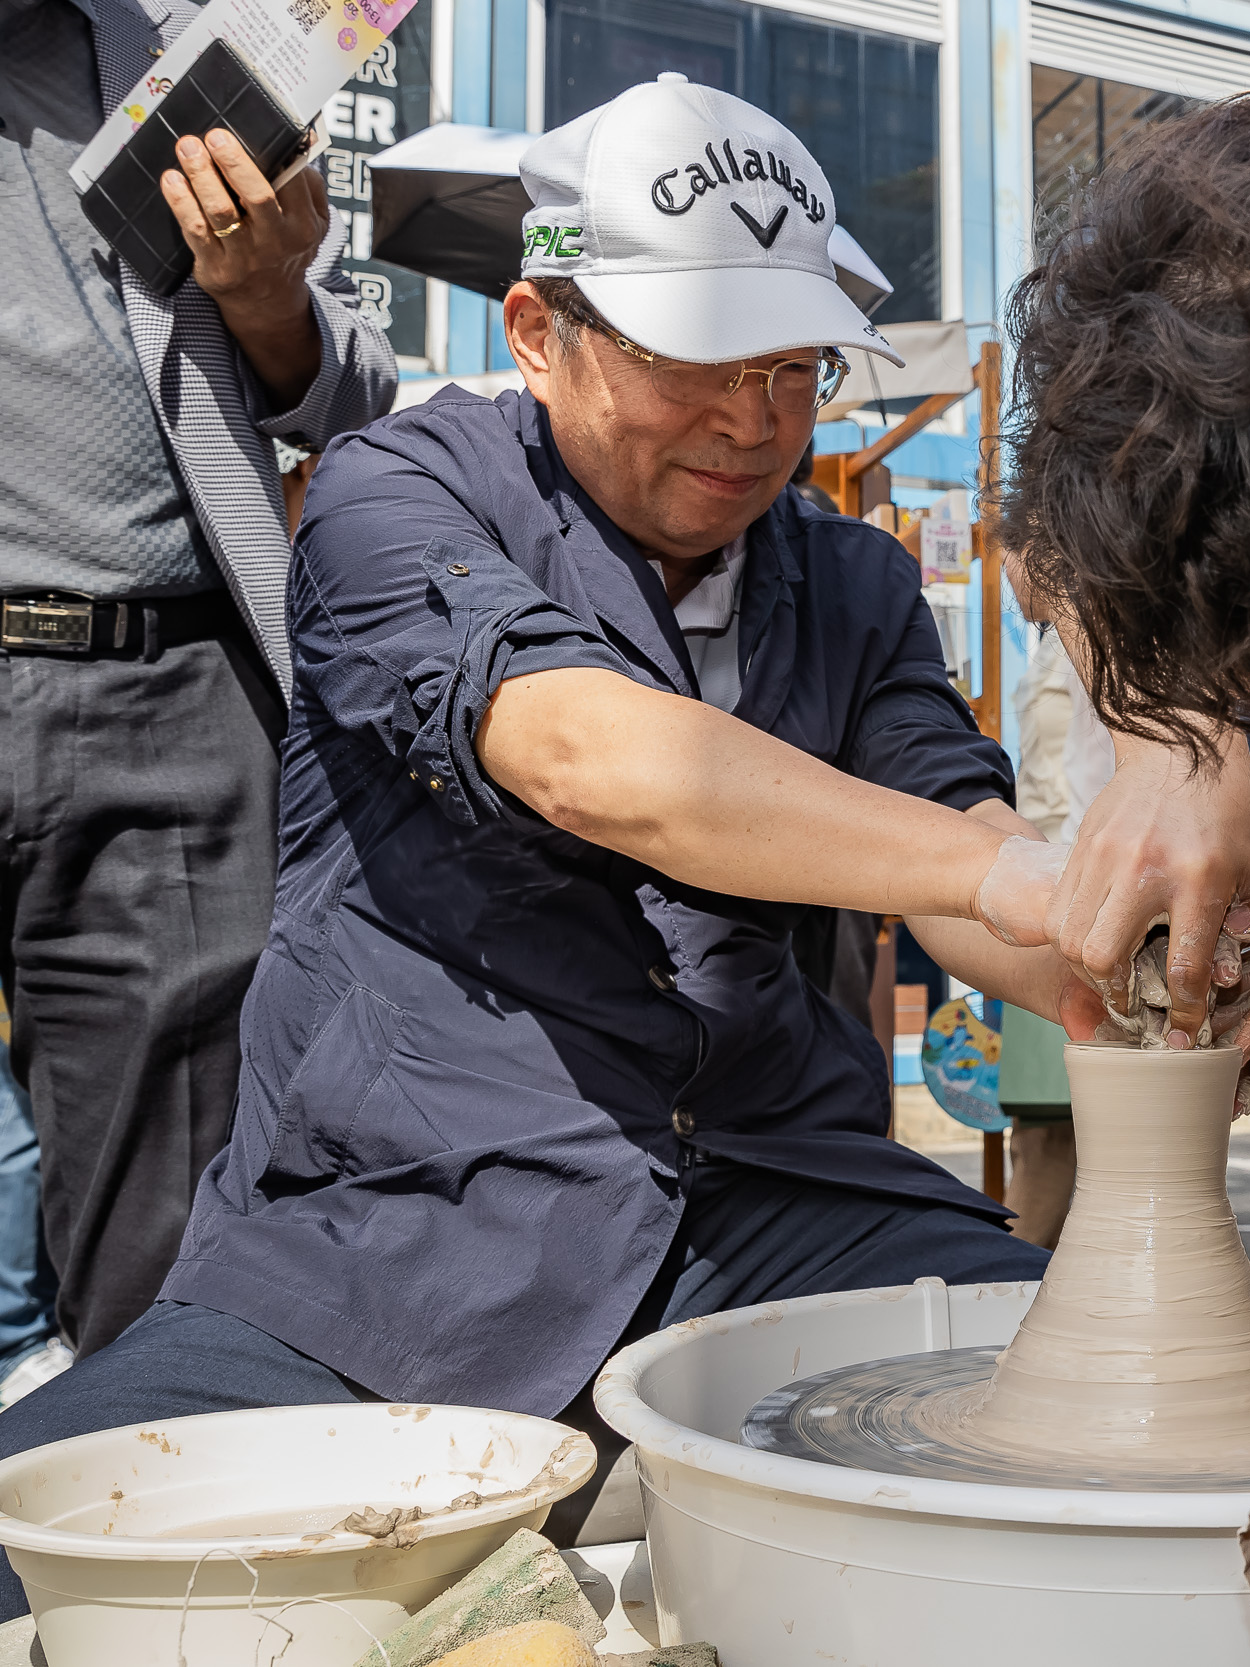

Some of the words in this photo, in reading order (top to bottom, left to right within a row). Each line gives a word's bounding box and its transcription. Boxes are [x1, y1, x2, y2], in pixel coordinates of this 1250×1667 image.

[360, 0, 381, 24] 13:00
[652, 138, 826, 224] Callaway
[523, 225, 584, 257] EPIC
